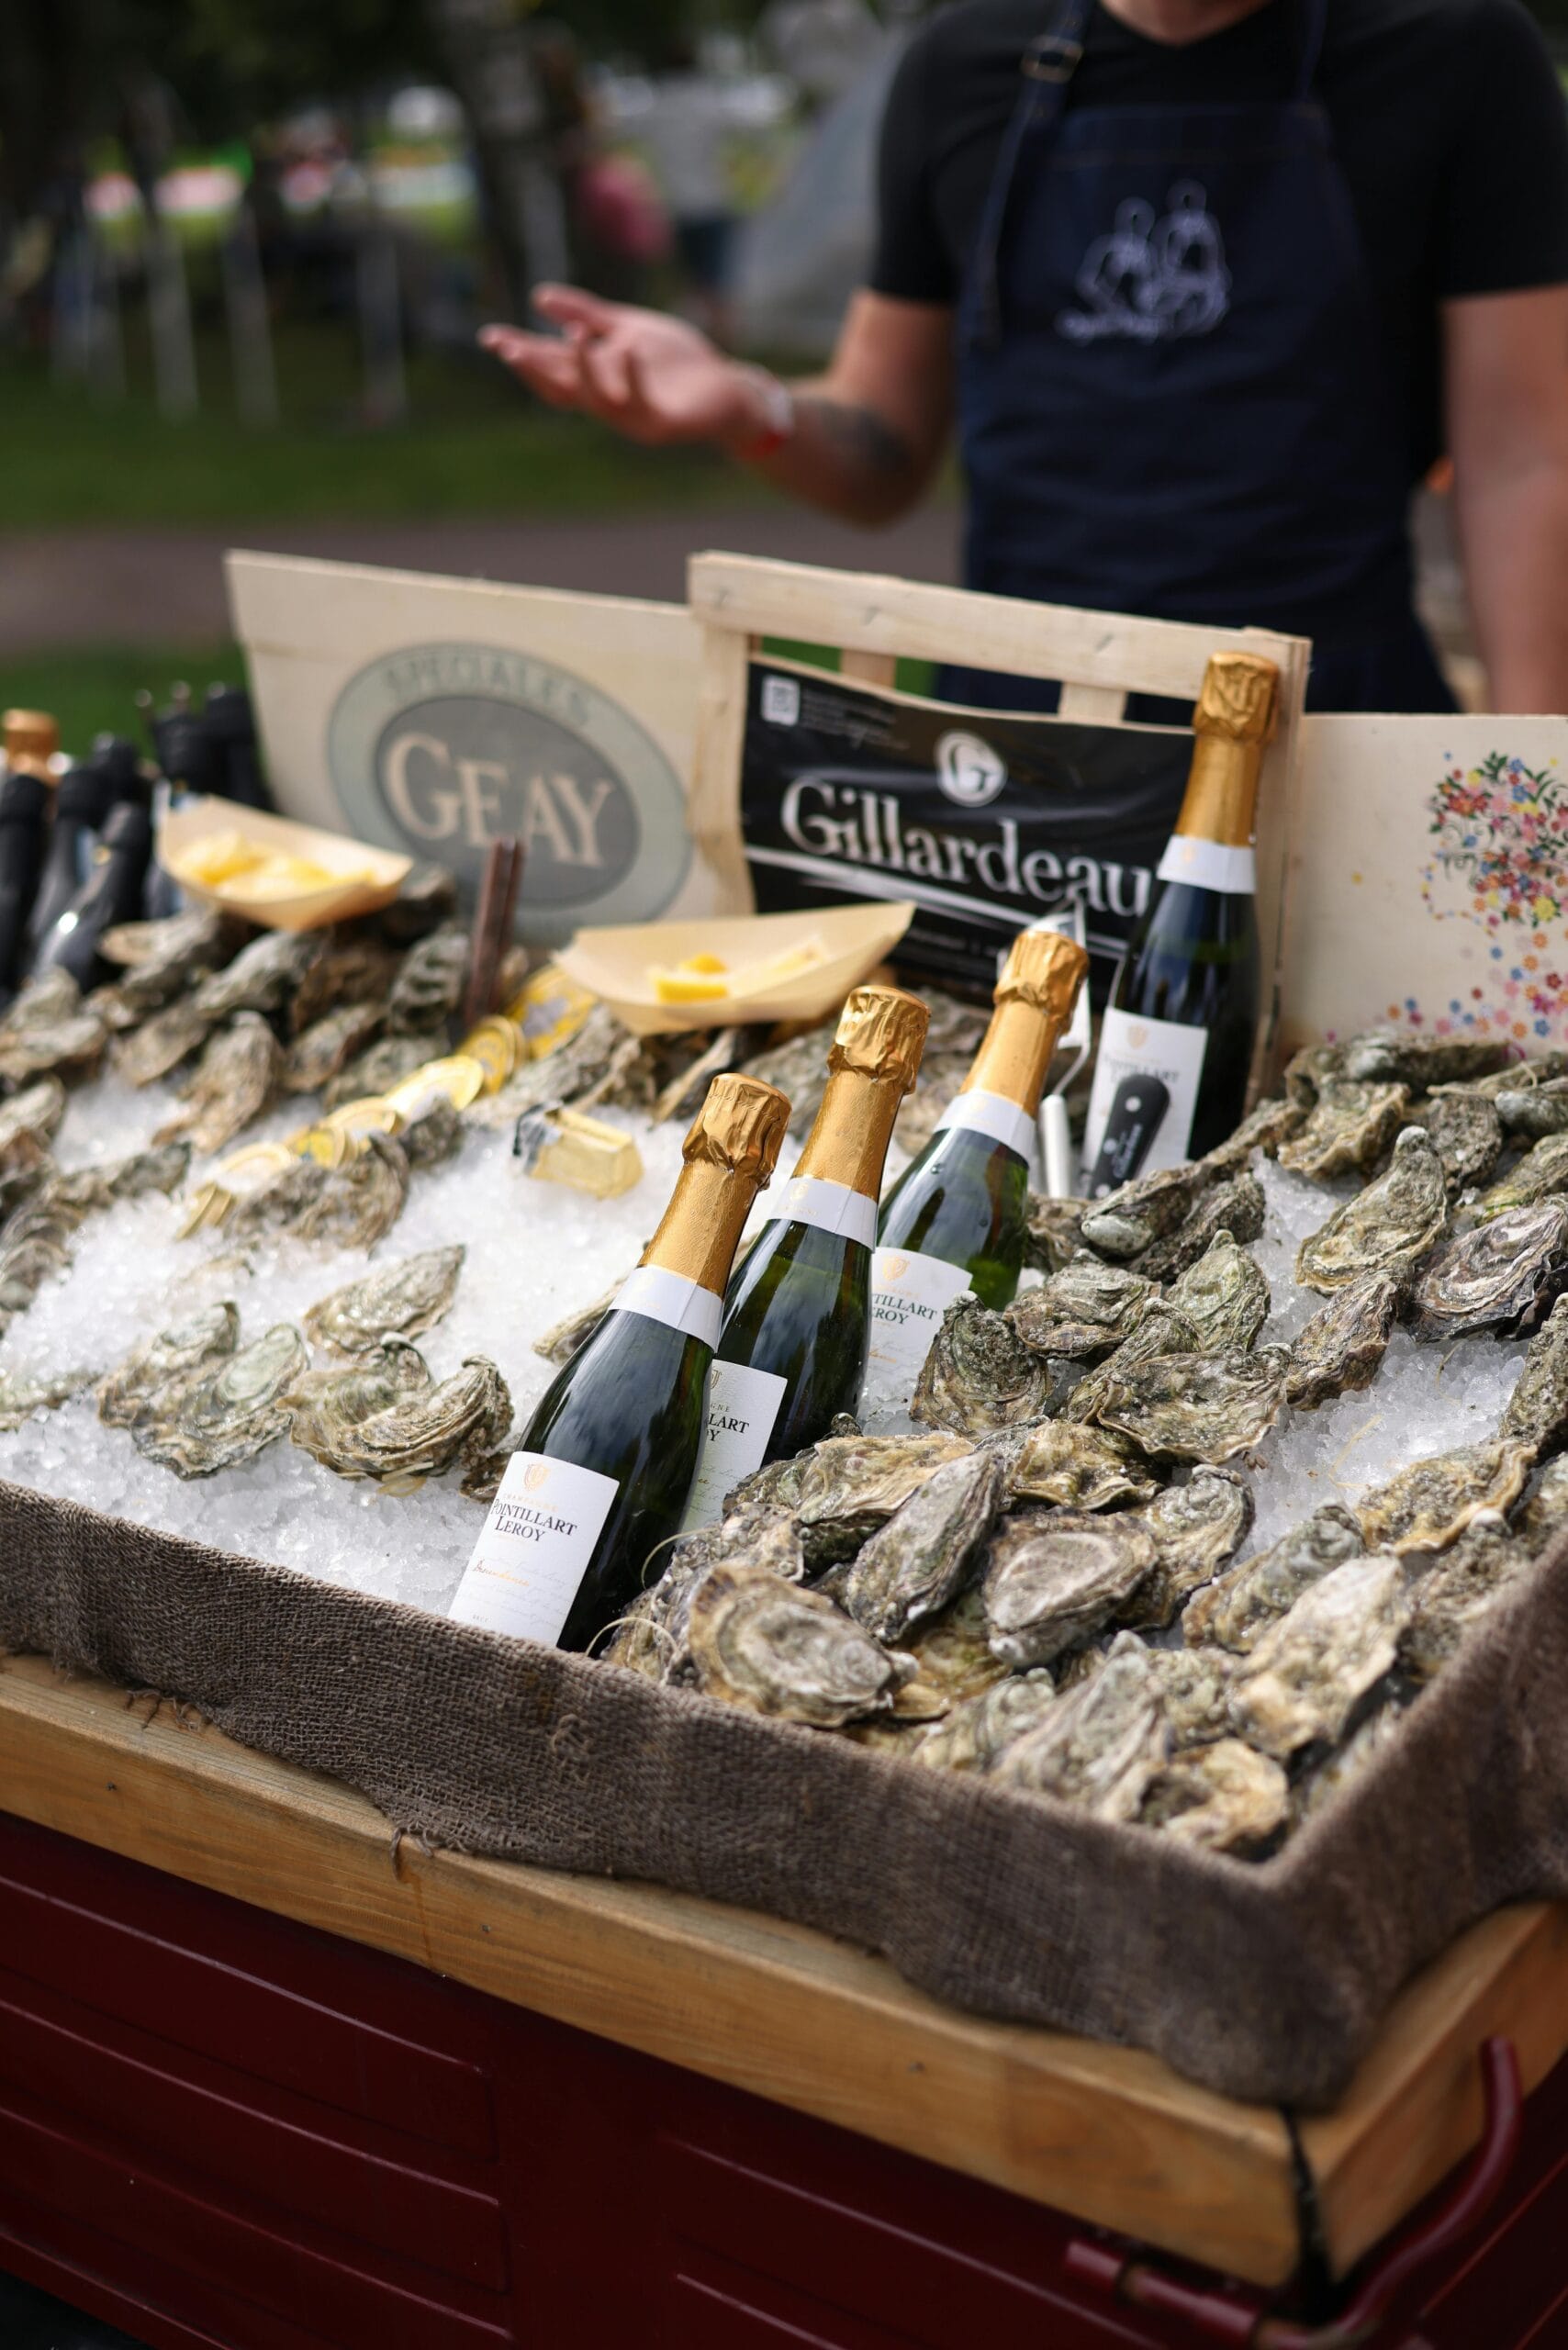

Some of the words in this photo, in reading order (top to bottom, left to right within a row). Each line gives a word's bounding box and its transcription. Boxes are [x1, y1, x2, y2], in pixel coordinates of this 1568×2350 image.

[385, 731, 616, 868] GEAY
[780, 776, 1153, 918] Gillardeau
[872, 1293, 937, 1321] TILLART
[490, 1498, 578, 1537] POINTILLART
[494, 1515, 546, 1542] LEROY
